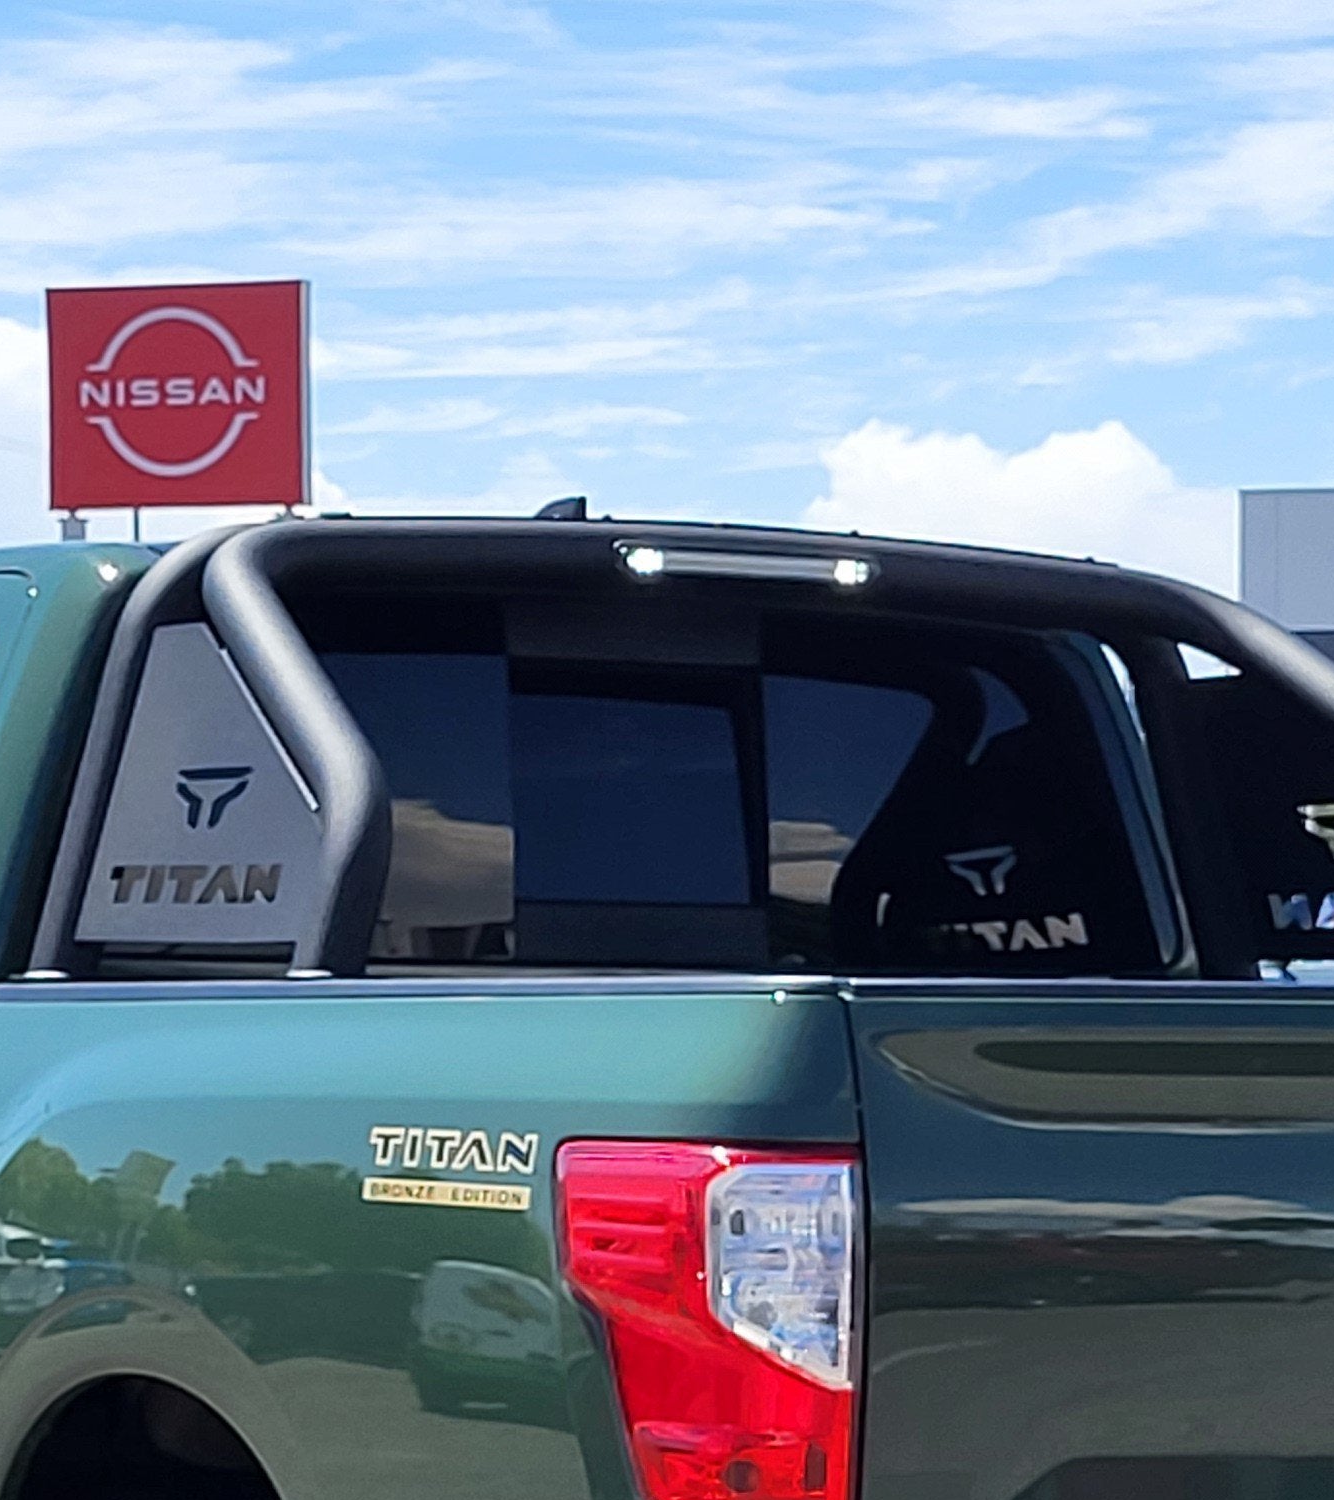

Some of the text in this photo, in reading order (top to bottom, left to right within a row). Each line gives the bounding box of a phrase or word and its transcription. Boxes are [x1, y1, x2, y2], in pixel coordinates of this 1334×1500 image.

[79, 376, 265, 408] NISSAN
[111, 863, 282, 905] TITAN
[939, 912, 1090, 951] TAN
[370, 1126, 540, 1175] TITAN
[370, 1182, 522, 1205] BRONZE EDITION
